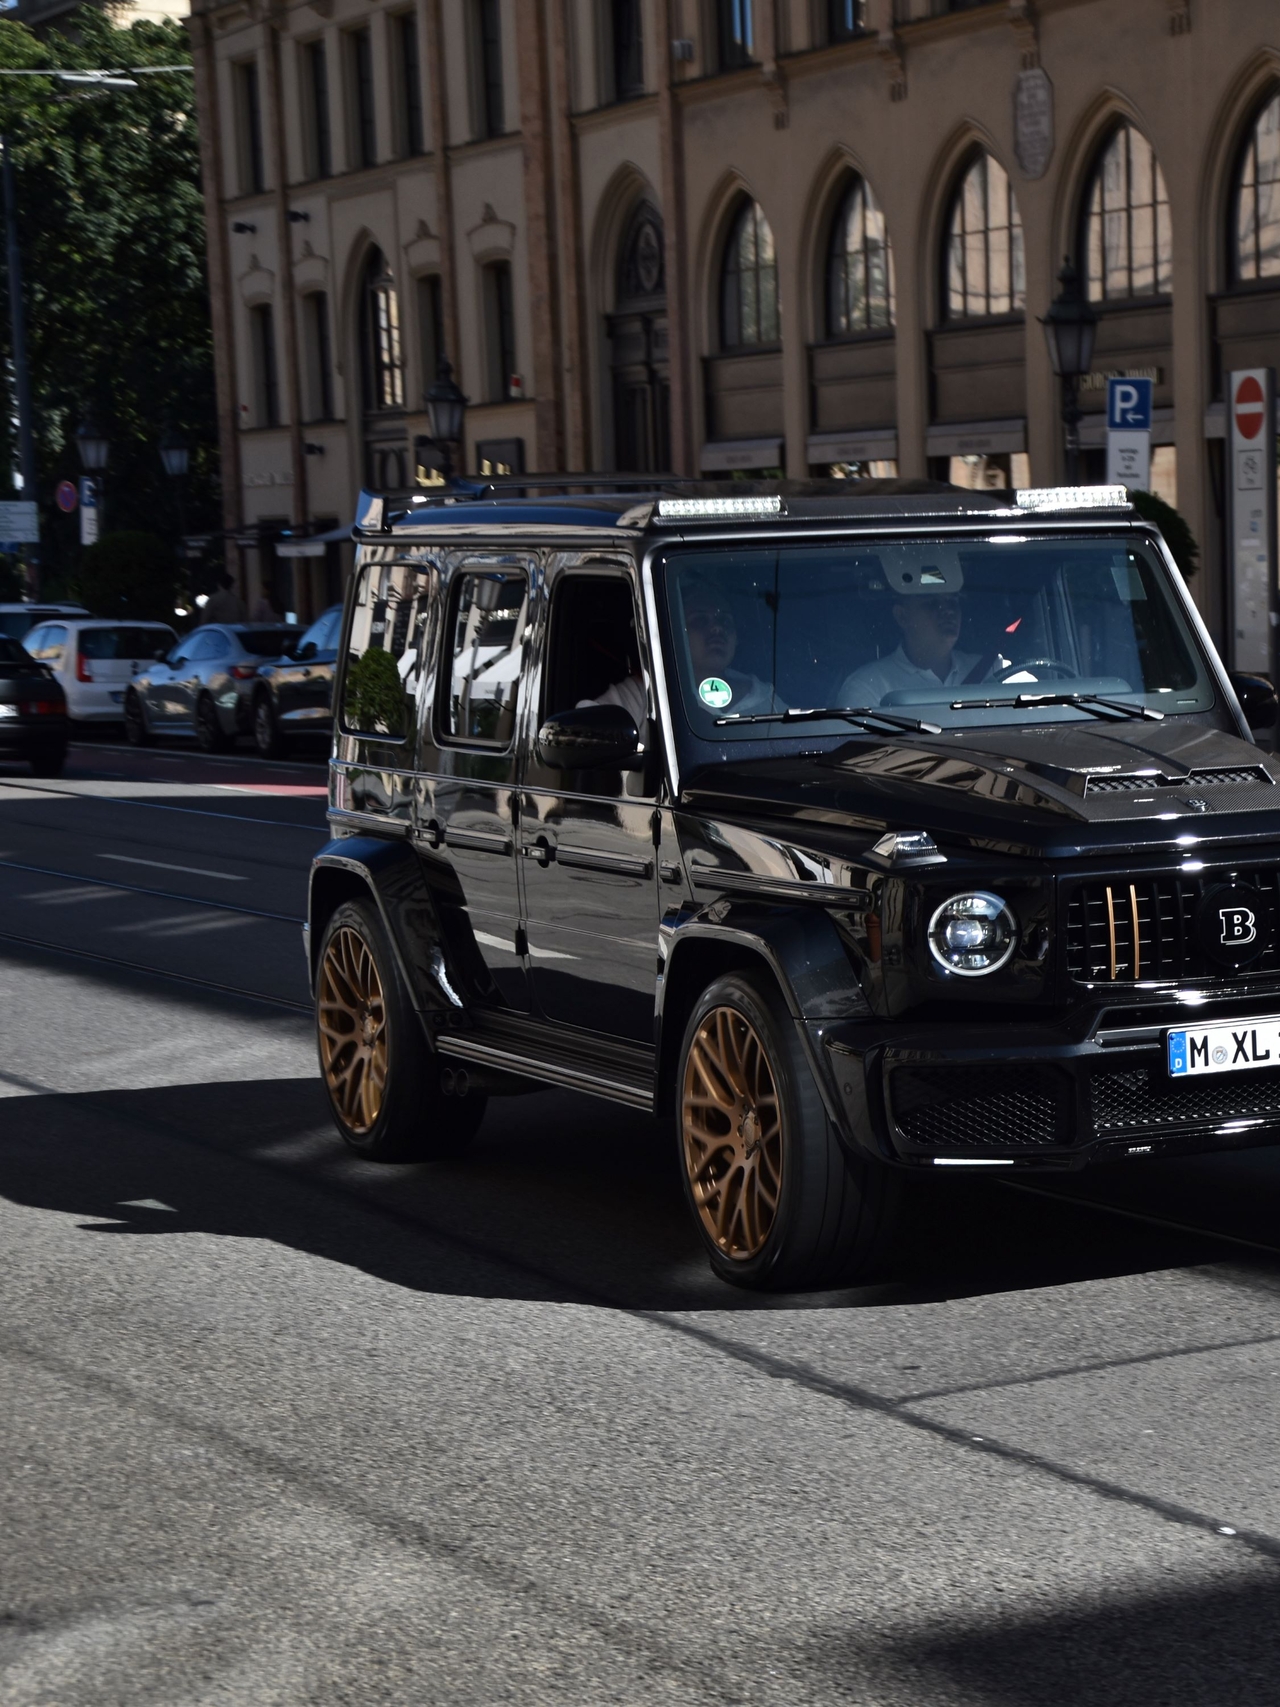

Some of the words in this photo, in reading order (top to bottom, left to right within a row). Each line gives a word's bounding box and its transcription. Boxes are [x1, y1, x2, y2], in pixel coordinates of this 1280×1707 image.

[1114, 384, 1139, 424] P
[710, 680, 719, 692] 4
[1219, 907, 1257, 946] B
[1174, 1058, 1183, 1069] D
[1189, 1035, 1209, 1068] M
[1231, 1030, 1270, 1063] XL
